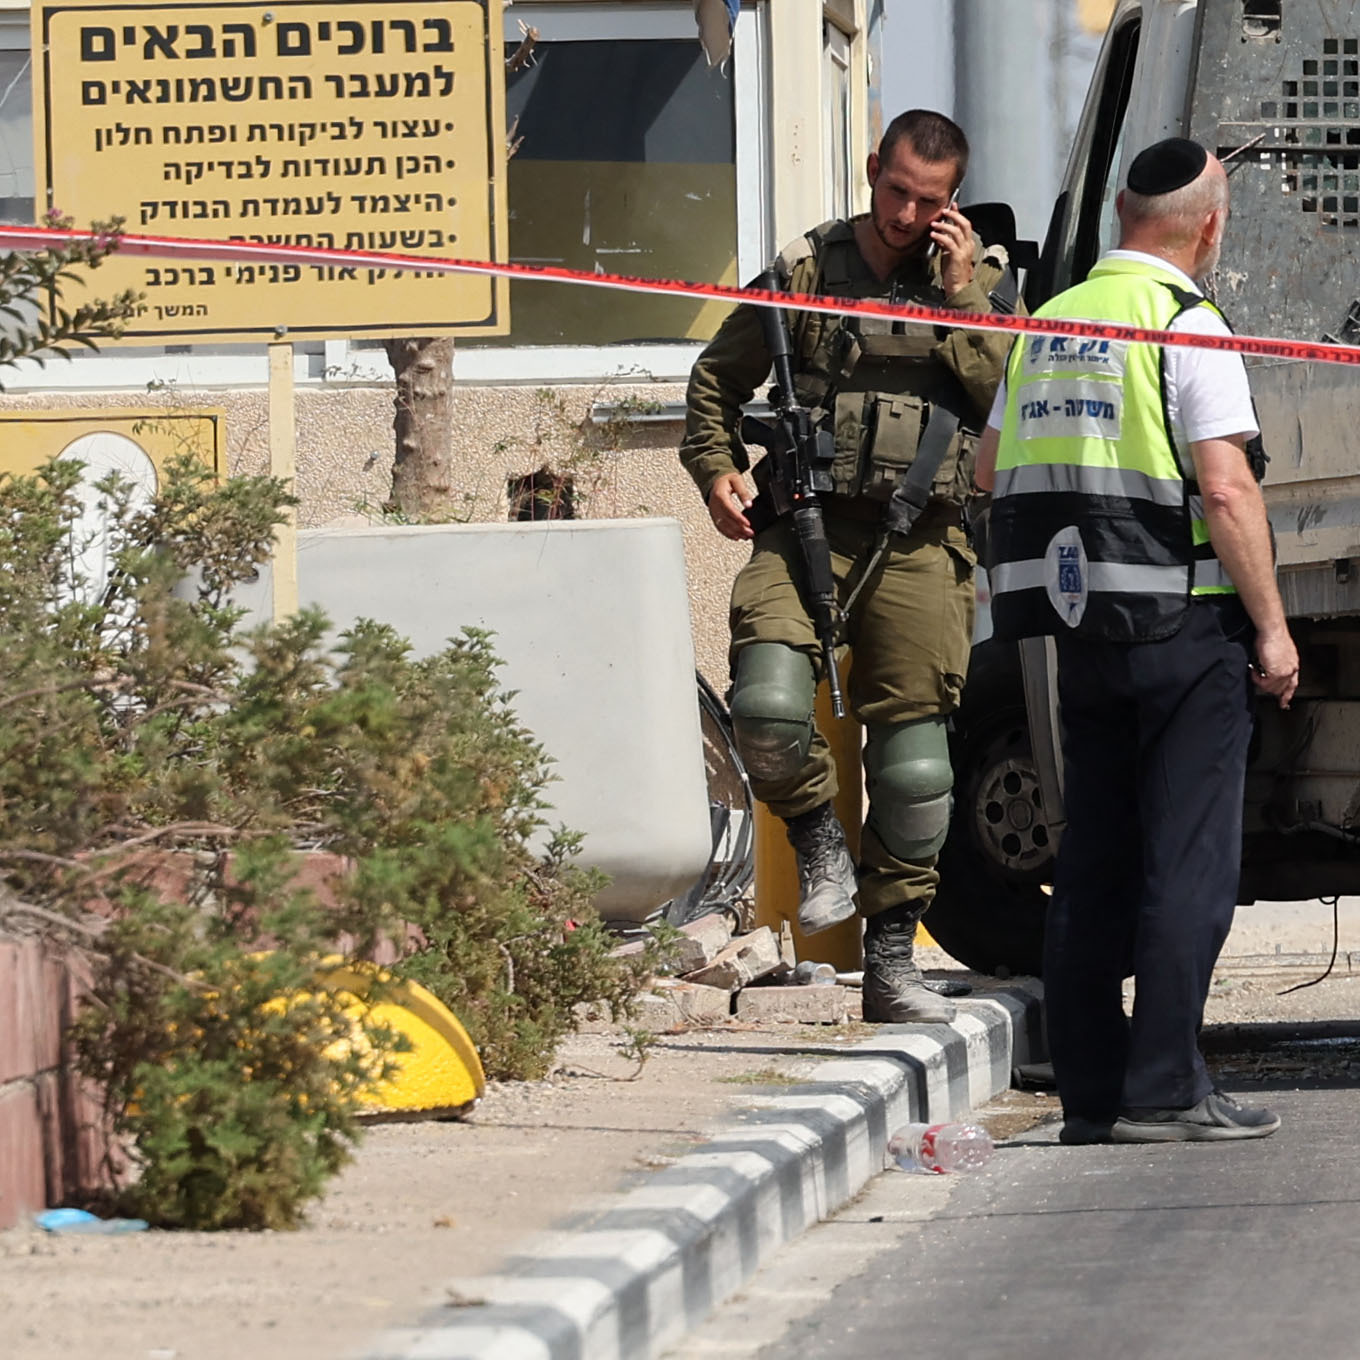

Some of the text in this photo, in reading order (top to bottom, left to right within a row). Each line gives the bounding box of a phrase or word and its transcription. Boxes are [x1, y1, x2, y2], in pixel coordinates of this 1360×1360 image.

[80, 18, 455, 62] ברוכים הבאים
[81, 64, 454, 106] למעבר החשמונאים
[95, 116, 441, 152] עצור לביקורת ופתח חלון
[163, 155, 443, 185] הכן תעודות לבדיקה
[139, 191, 444, 225] היצמד לעמדת הבודק
[344, 229, 446, 249] בשעות
[145, 266, 216, 287] ברכב
[225, 262, 301, 284] פנימי
[310, 264, 358, 281] אור
[153, 304, 209, 320] המשך
